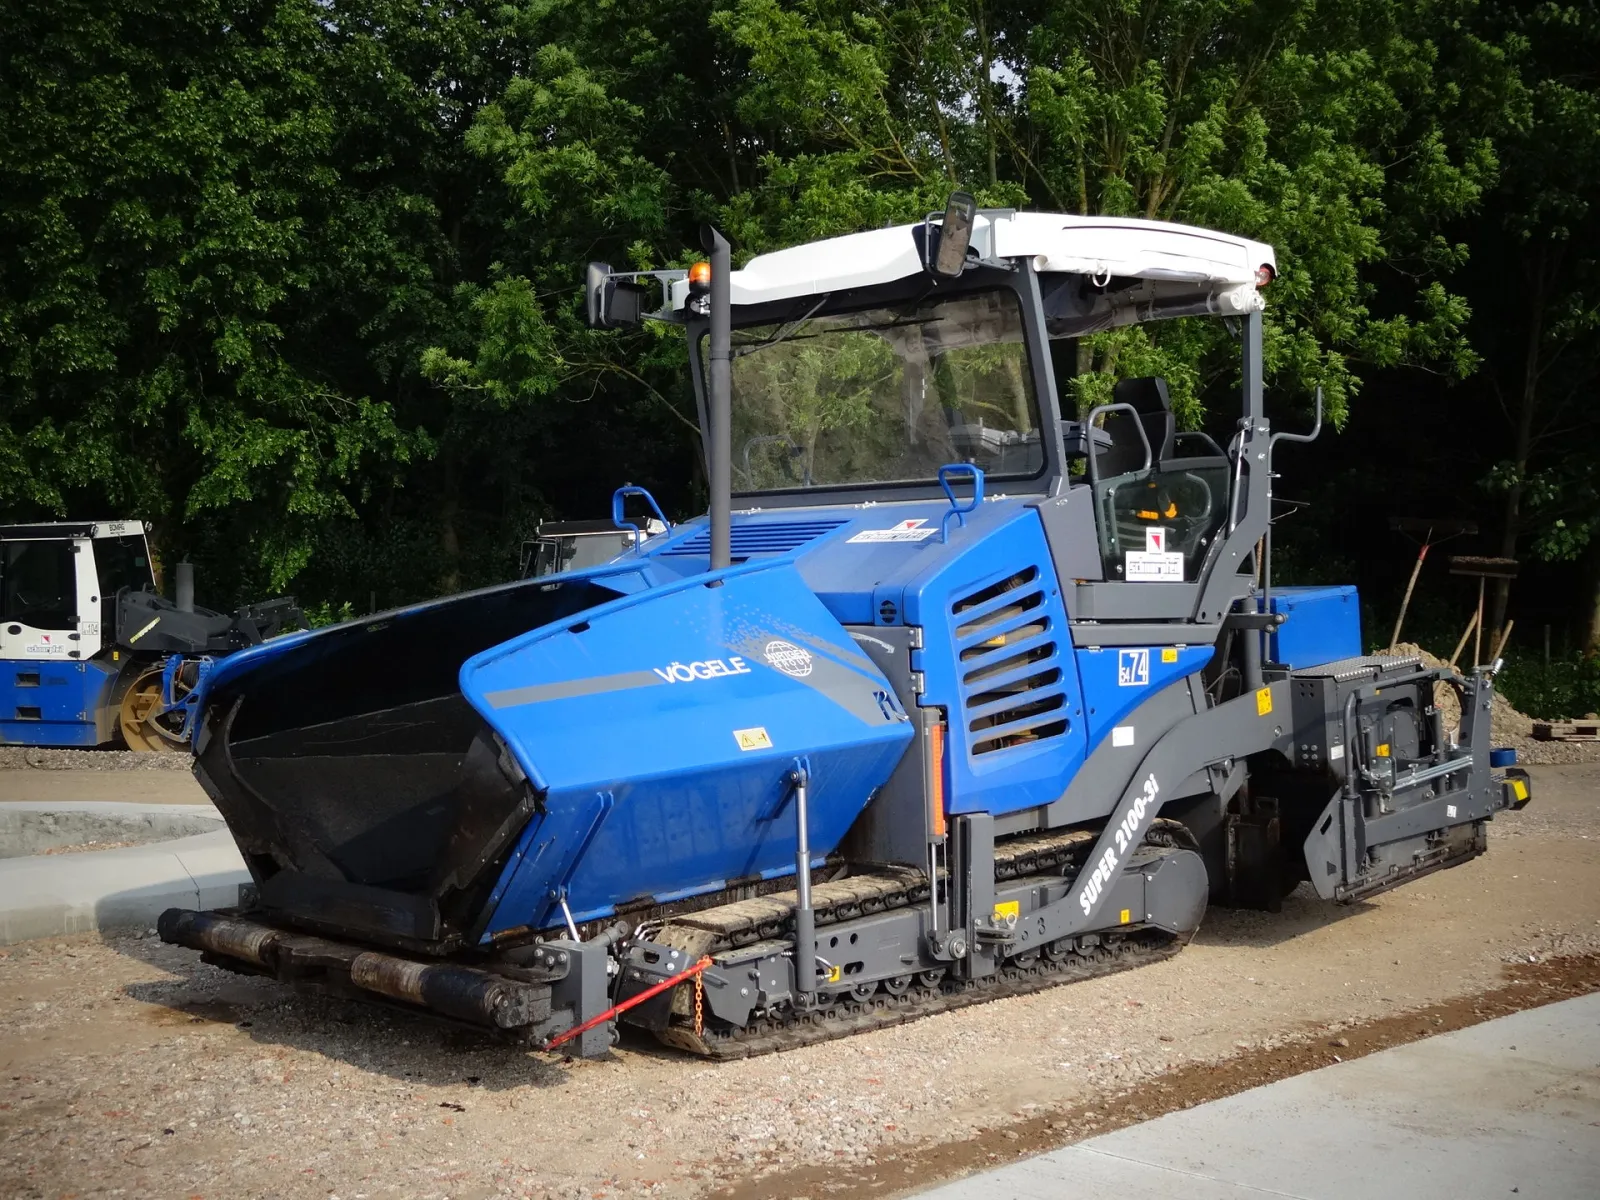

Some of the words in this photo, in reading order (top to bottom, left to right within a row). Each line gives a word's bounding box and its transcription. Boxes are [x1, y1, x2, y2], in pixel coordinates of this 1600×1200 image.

[653, 656, 751, 684] VÖGELE
[763, 648, 812, 663] WIRTGEN
[1130, 652, 1147, 683] 74
[1080, 847, 1119, 917] SUPER
[1115, 772, 1160, 855] 2100-3i
